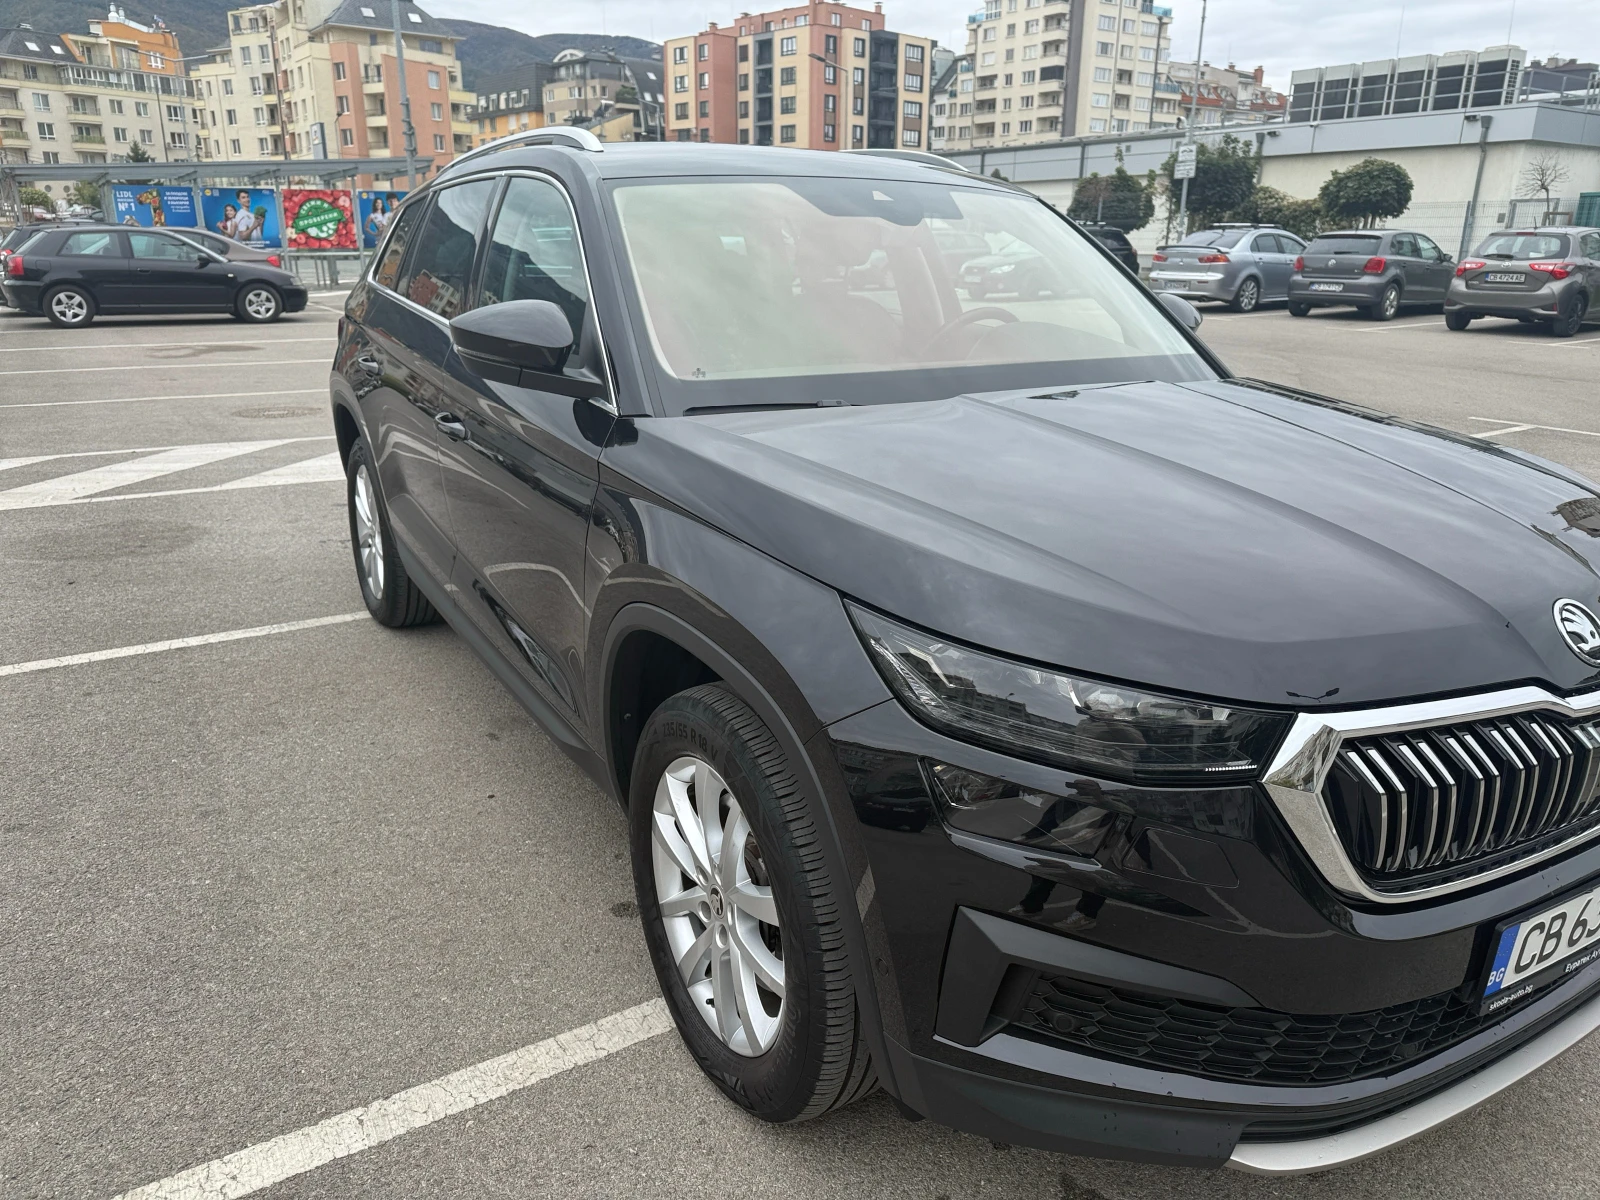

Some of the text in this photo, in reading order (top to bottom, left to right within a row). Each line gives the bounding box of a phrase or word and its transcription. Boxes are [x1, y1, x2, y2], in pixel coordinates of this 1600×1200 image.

[662, 721, 688, 739] 235/55
[690, 728, 697, 744] R
[698, 733, 708, 753] 18
[1514, 911, 1568, 974] CB
[1487, 967, 1505, 986] BG
[1489, 984, 1533, 1011] skoda-auto.bg
